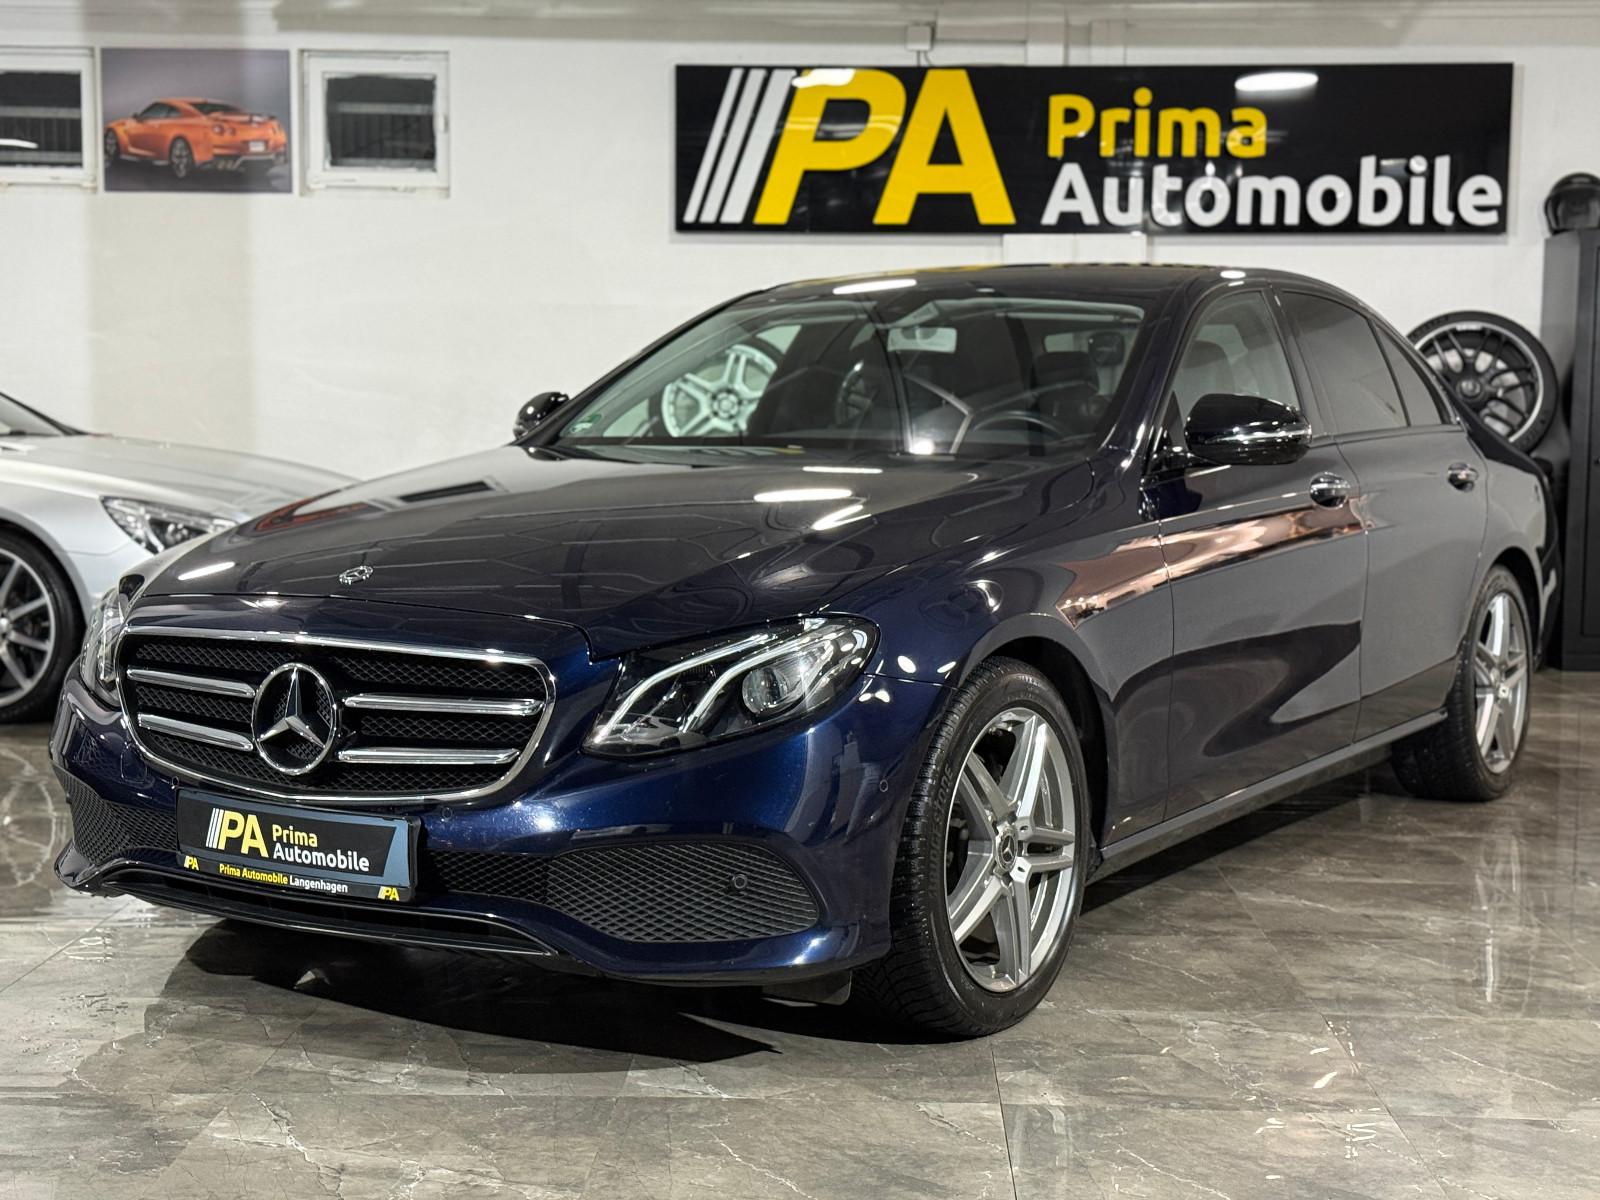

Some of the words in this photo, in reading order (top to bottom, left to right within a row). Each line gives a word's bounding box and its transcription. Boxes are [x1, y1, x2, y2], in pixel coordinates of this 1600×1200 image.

[1047, 87, 1268, 159] Prima
[752, 67, 1017, 226] PA
[1040, 153, 1503, 228] Automobile
[216, 810, 270, 859] PA
[271, 824, 318, 849] Prima
[186, 856, 200, 871] PA
[272, 842, 370, 872] Automobile
[219, 863, 241, 877] Prima
[241, 868, 289, 885] Automobile
[289, 875, 348, 894] Langenhagen
[382, 885, 400, 901] PA
